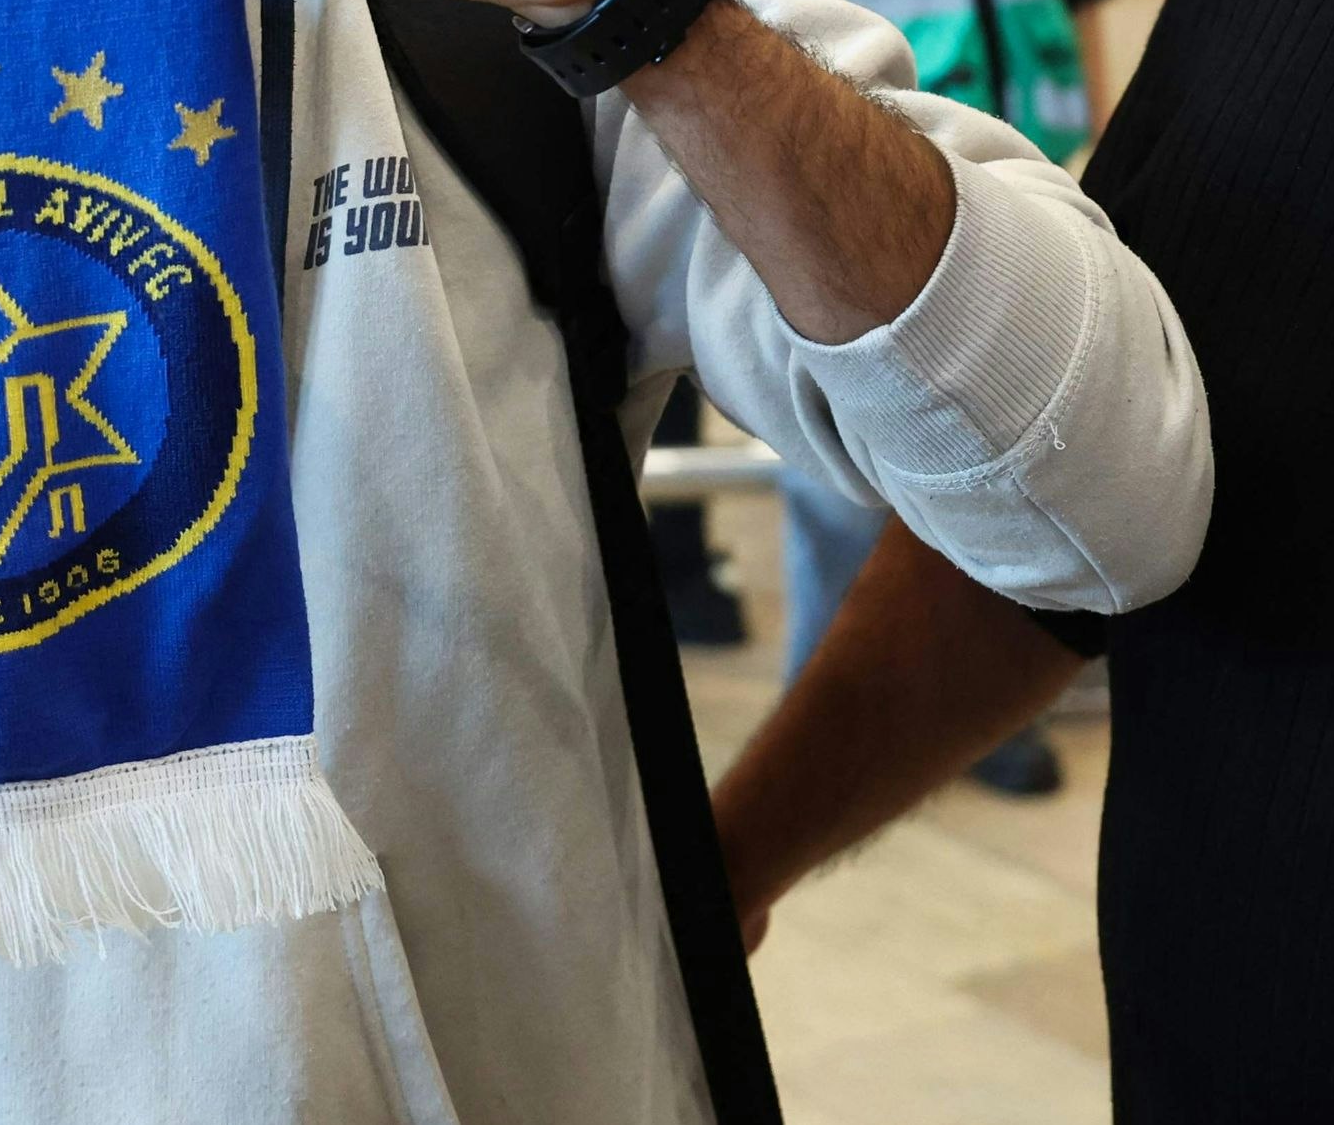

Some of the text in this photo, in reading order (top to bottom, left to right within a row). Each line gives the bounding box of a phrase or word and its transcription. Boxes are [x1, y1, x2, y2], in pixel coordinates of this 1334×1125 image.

[312, 163, 351, 217] THE
[35, 187, 150, 256] AVIV
[127, 243, 192, 301] FC
[304, 200, 430, 270] IS YOU
[22, 548, 120, 614] 1906
